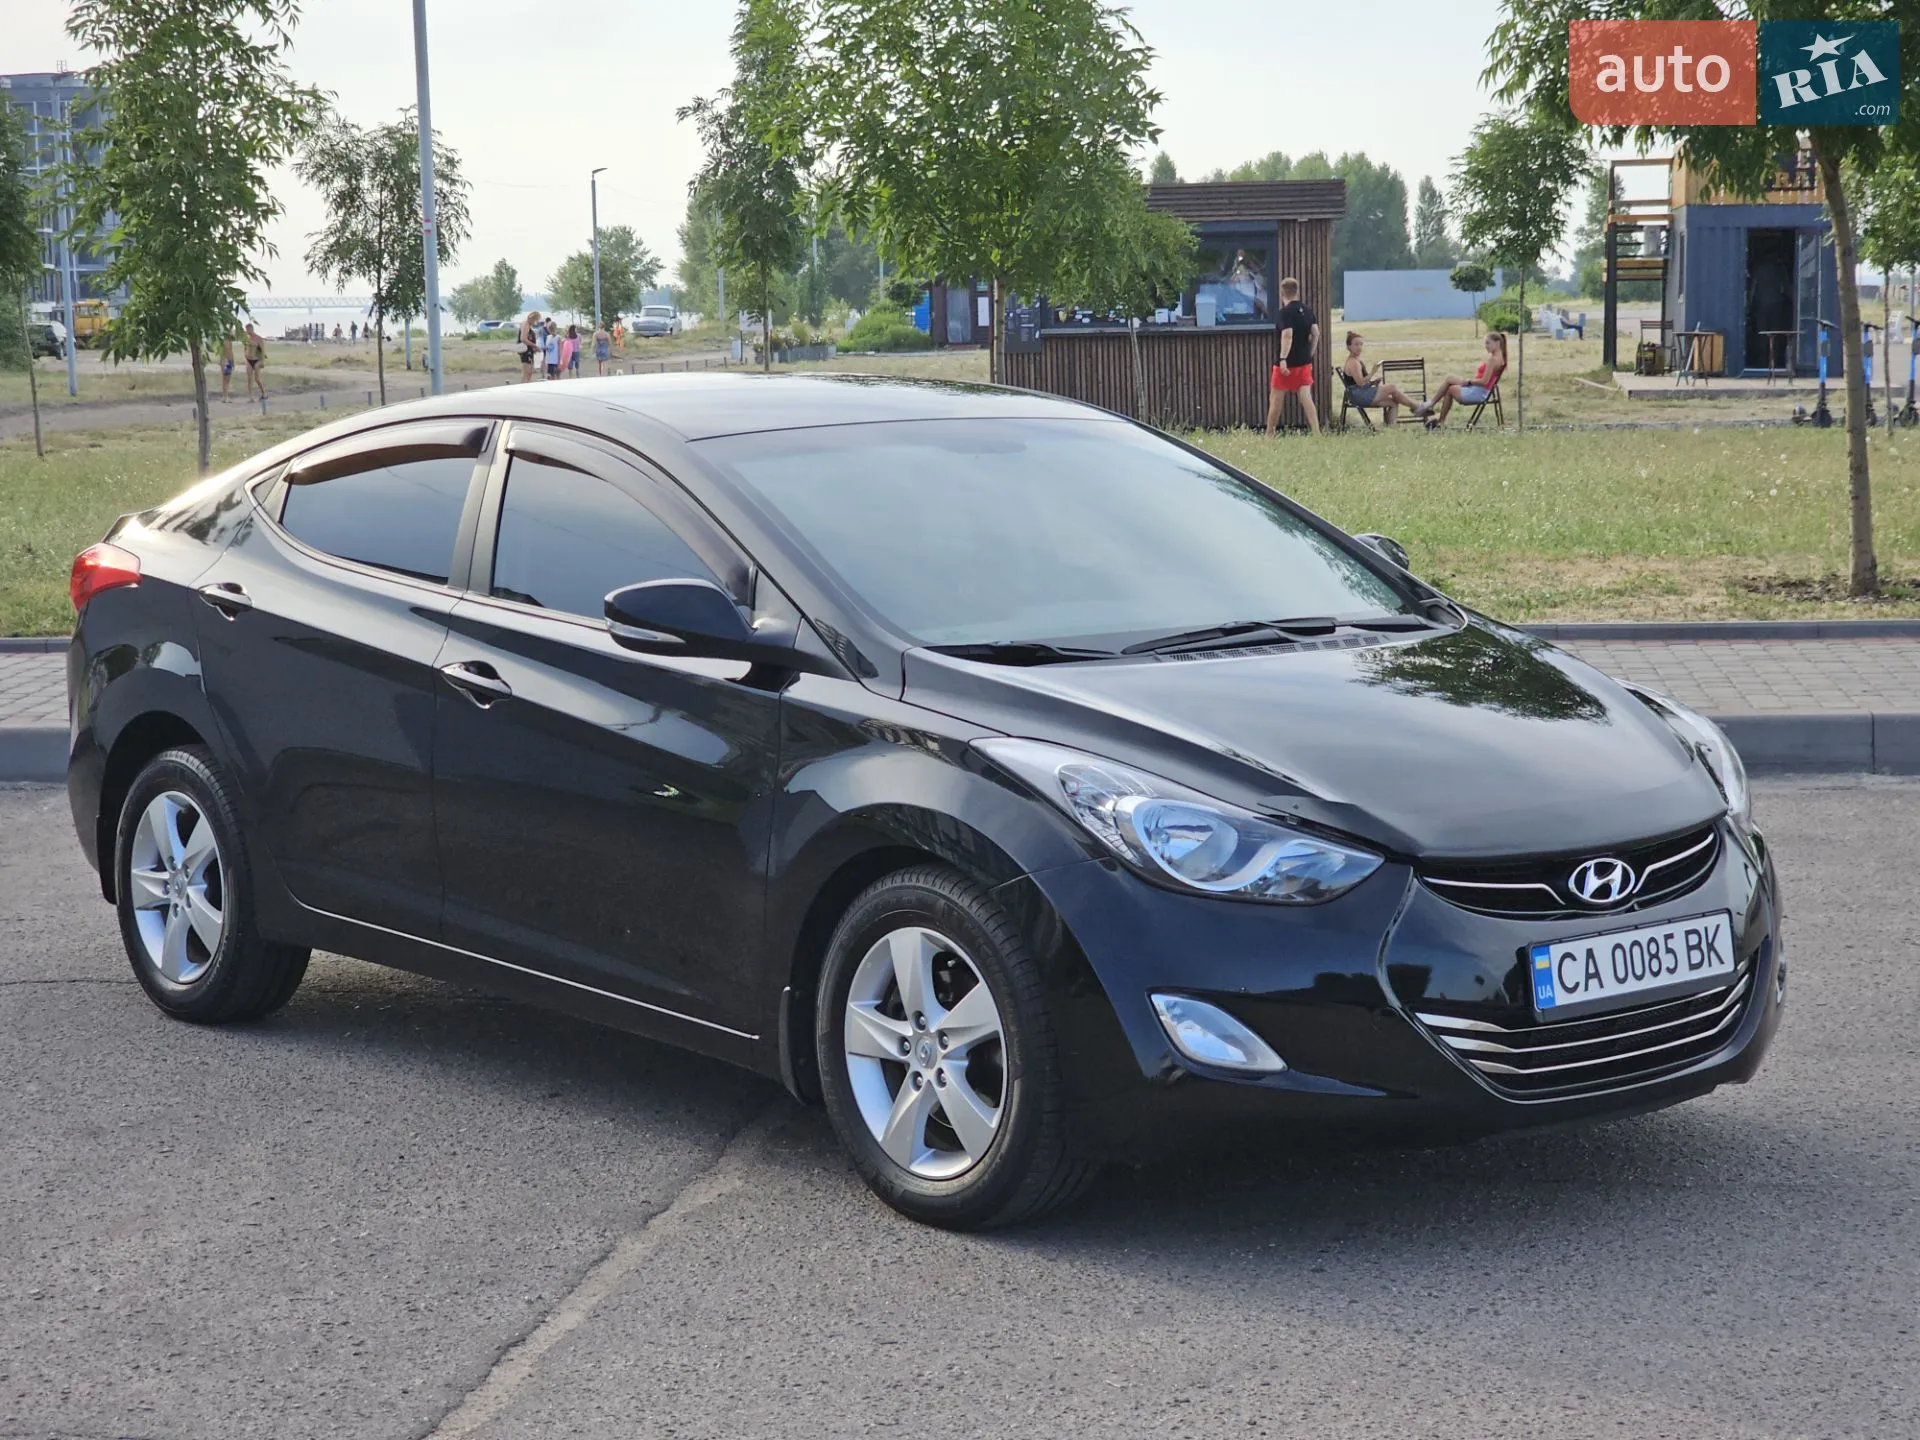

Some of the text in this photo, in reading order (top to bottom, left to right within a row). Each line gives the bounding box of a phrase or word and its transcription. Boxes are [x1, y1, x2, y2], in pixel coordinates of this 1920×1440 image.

[1558, 924, 1725, 993] CA 0085 BK
[1538, 984, 1554, 999] UA
